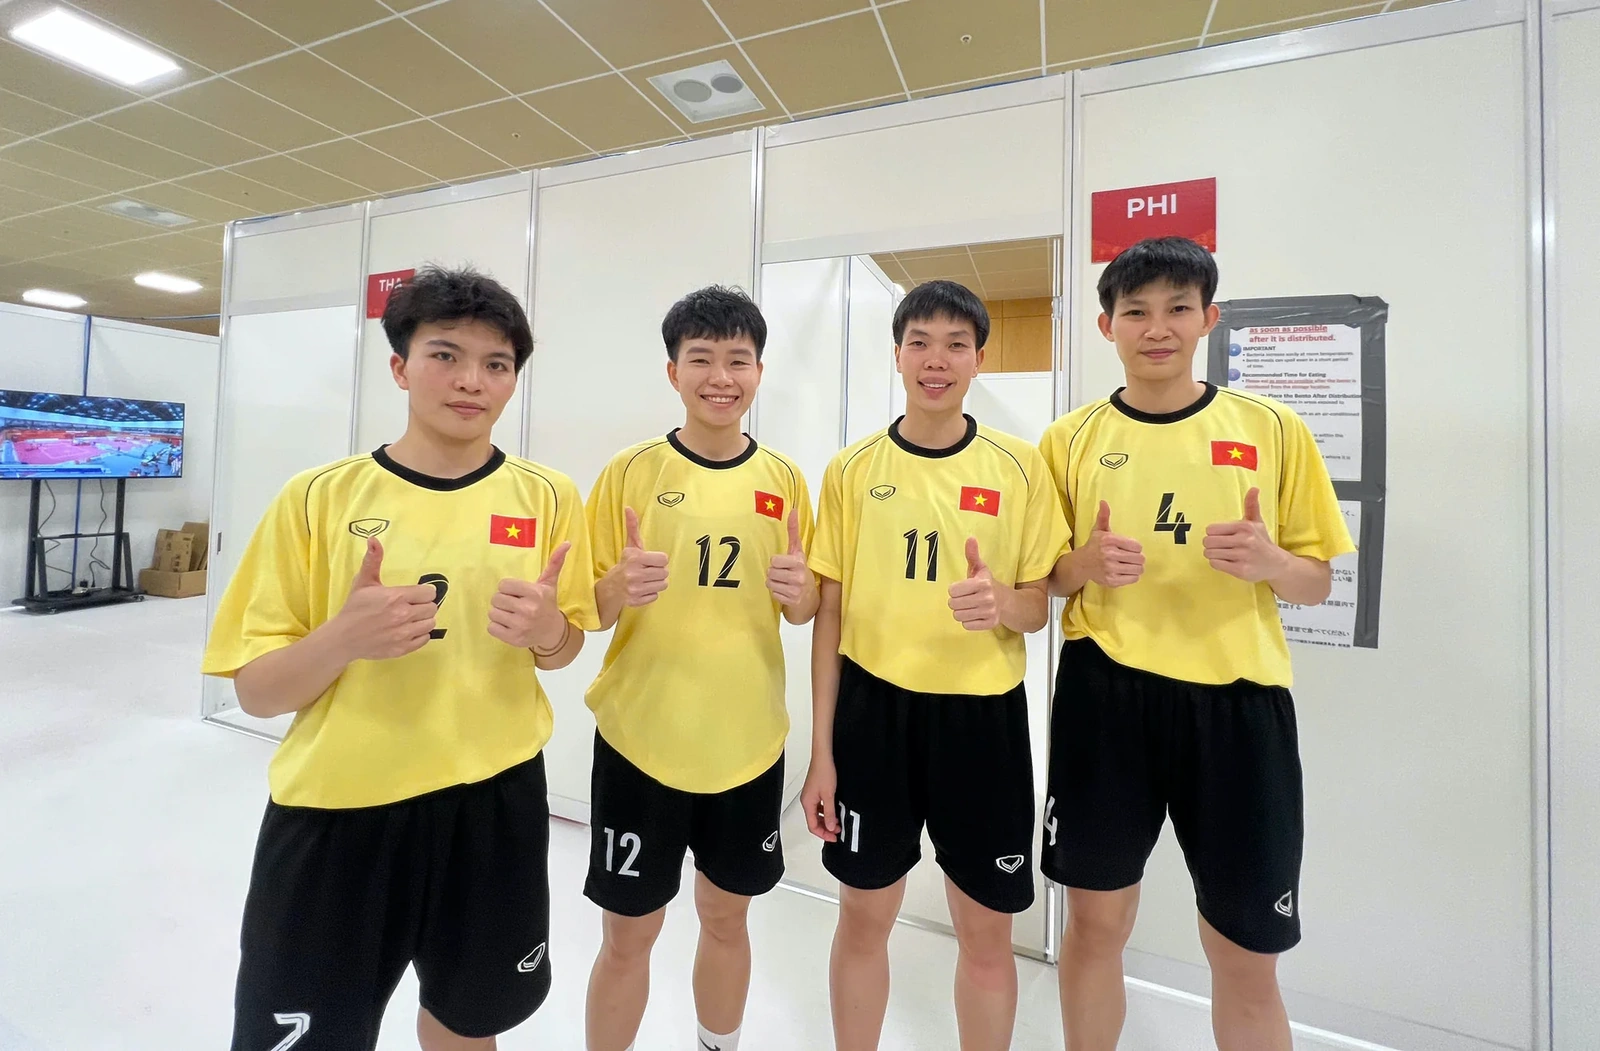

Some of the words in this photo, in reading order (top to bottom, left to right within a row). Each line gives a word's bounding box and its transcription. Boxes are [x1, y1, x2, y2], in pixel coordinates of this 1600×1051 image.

[1127, 193, 1177, 219] PHI
[1287, 334, 1336, 342] distributed.
[1292, 324, 1328, 333] possible
[1153, 492, 1192, 545] 4
[695, 534, 741, 589] 12
[903, 528, 939, 582] 11
[604, 827, 642, 878] 12
